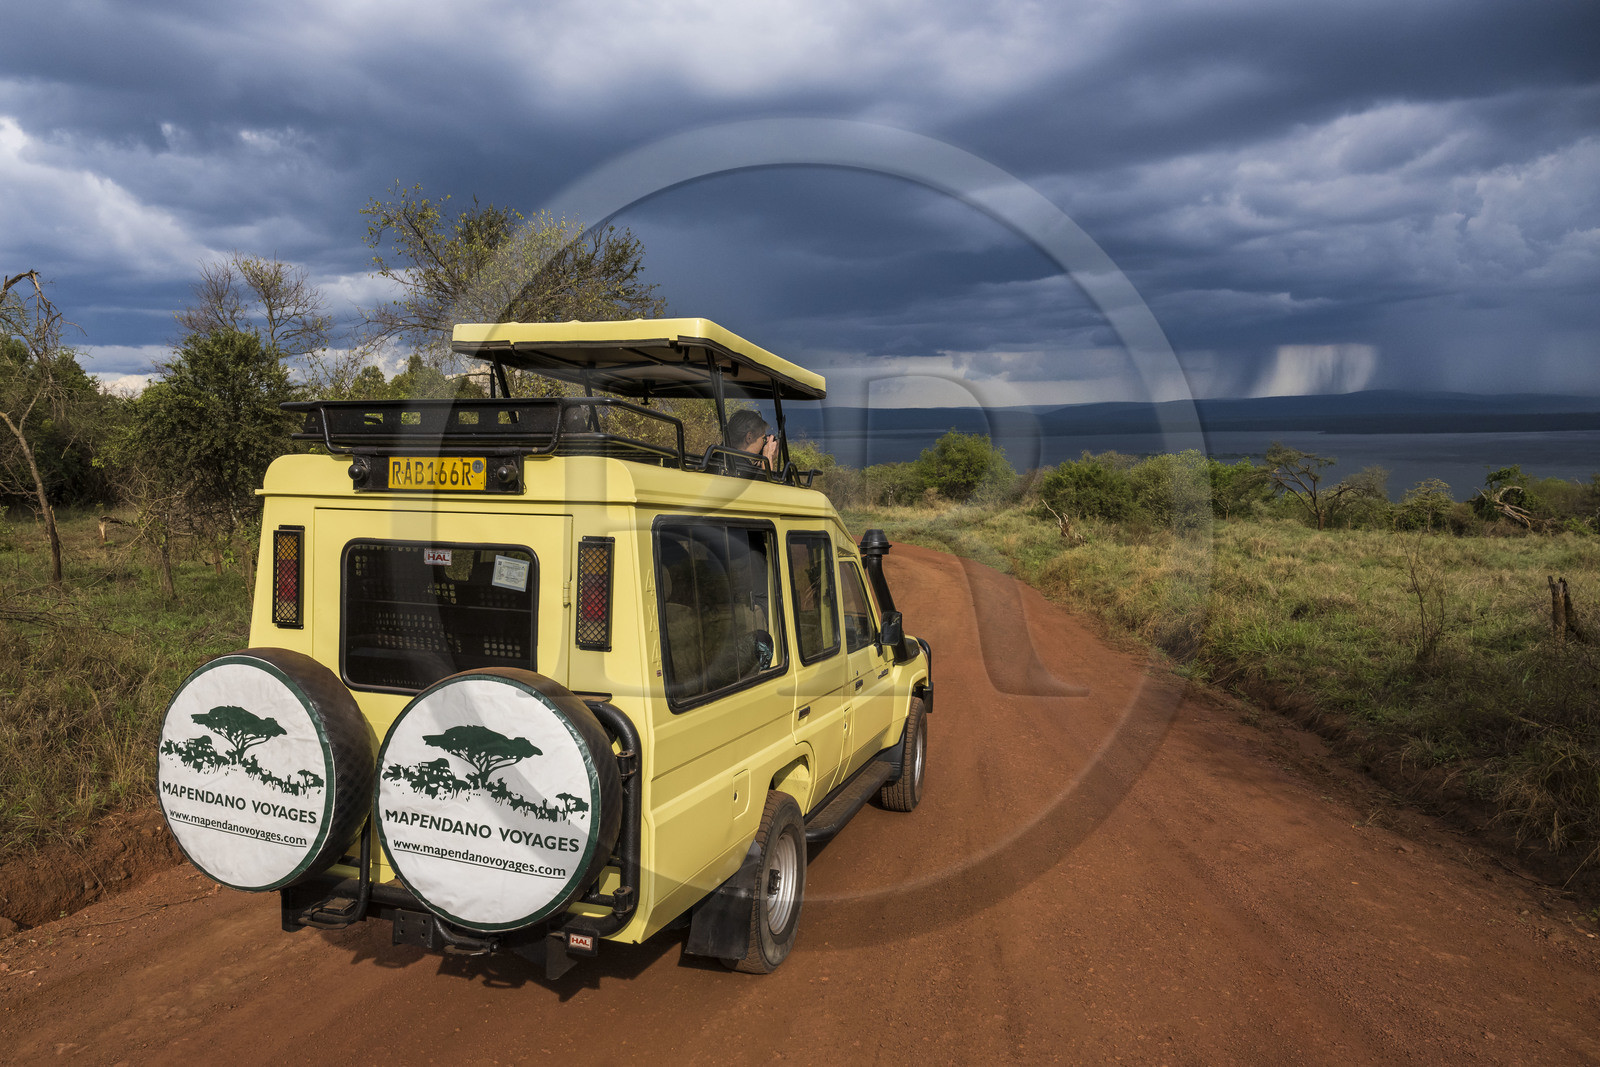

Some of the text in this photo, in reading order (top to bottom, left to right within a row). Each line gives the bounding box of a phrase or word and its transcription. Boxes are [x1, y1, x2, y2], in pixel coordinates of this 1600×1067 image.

[427, 553, 450, 562] HAL
[162, 780, 317, 825] MAPENDANO VOYAGES
[169, 809, 307, 847] www.mapendanovoyages.com
[385, 809, 580, 853] MAPENDANO VOYAGES
[393, 839, 566, 878] www.mapendanovoyages.com
[571, 937, 590, 947] HAL
